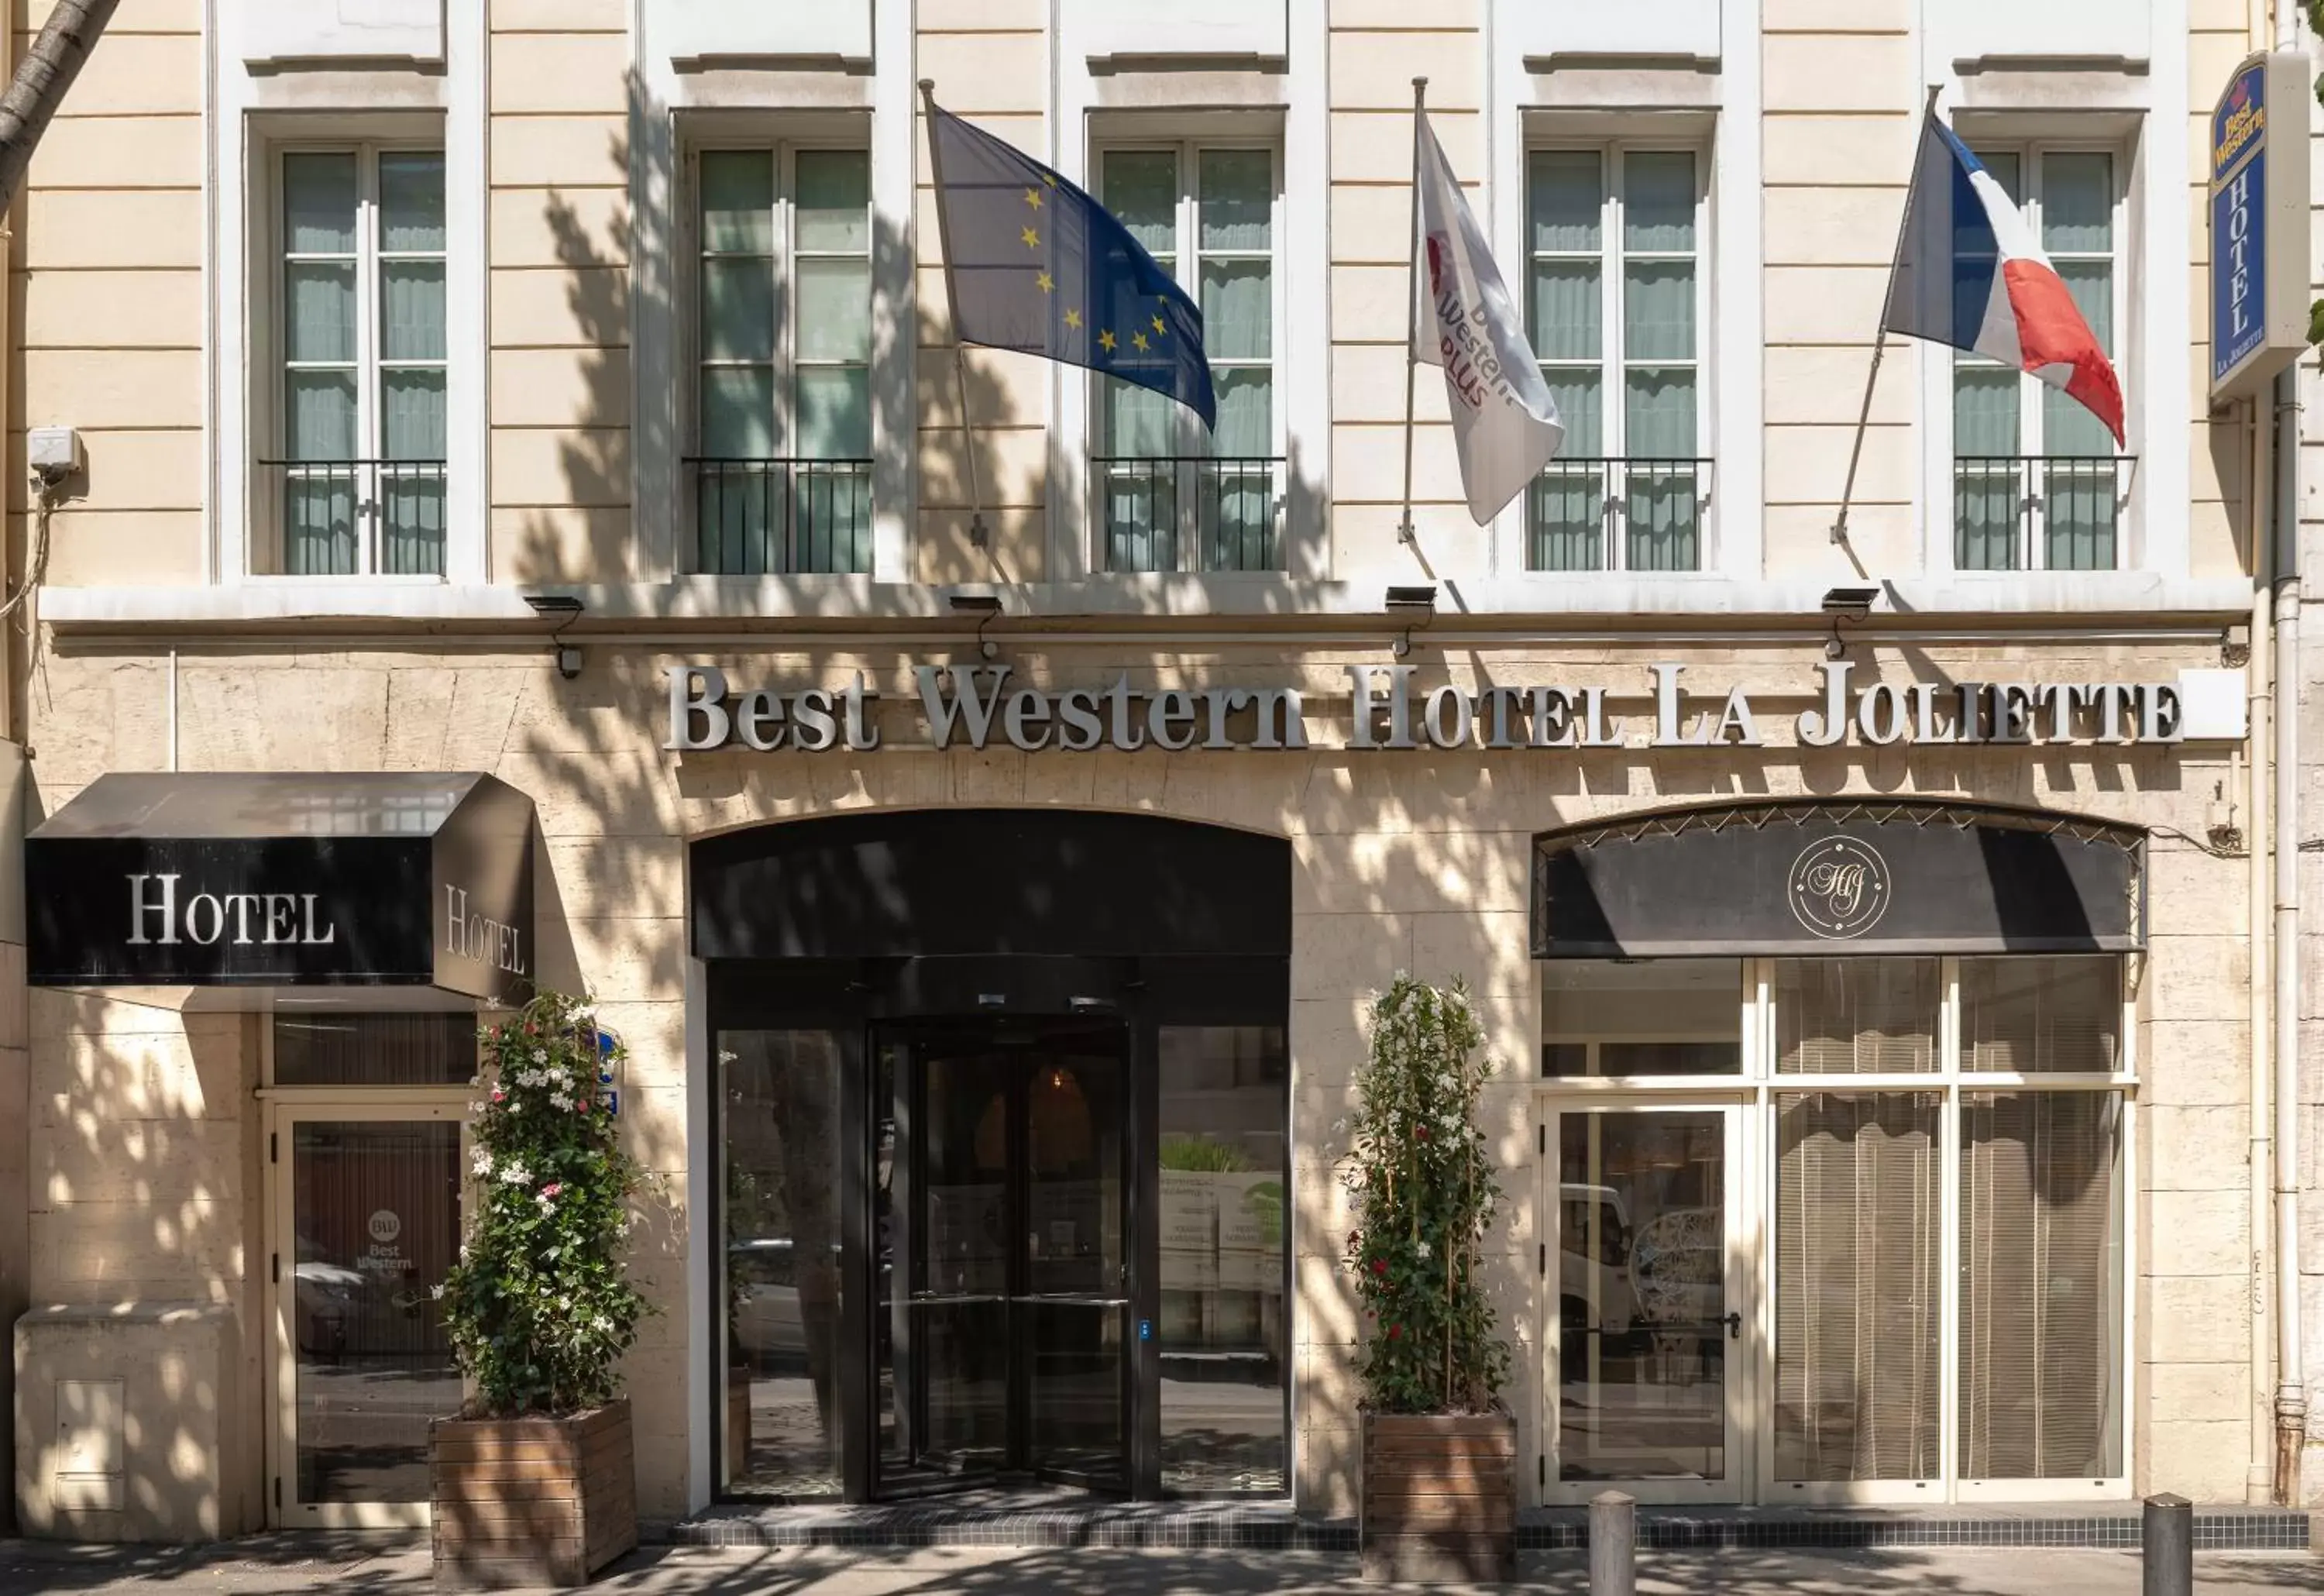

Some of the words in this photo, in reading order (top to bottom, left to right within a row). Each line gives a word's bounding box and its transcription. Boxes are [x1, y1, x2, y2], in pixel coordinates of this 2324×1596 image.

[2216, 107, 2264, 168] Western
[2226, 97, 2251, 139] Best
[2228, 170, 2250, 339] HOTEL
[662, 664, 879, 752] Best
[913, 663, 1309, 752] Western
[1344, 662, 1625, 748] HOTEL
[1648, 662, 1764, 746] LA
[1798, 660, 2185, 746] JOLIETTE
[125, 873, 335, 945] HOTEL
[445, 884, 525, 975] HOTEL
[357, 1257, 412, 1270] Western
[370, 1243, 401, 1257] Best
